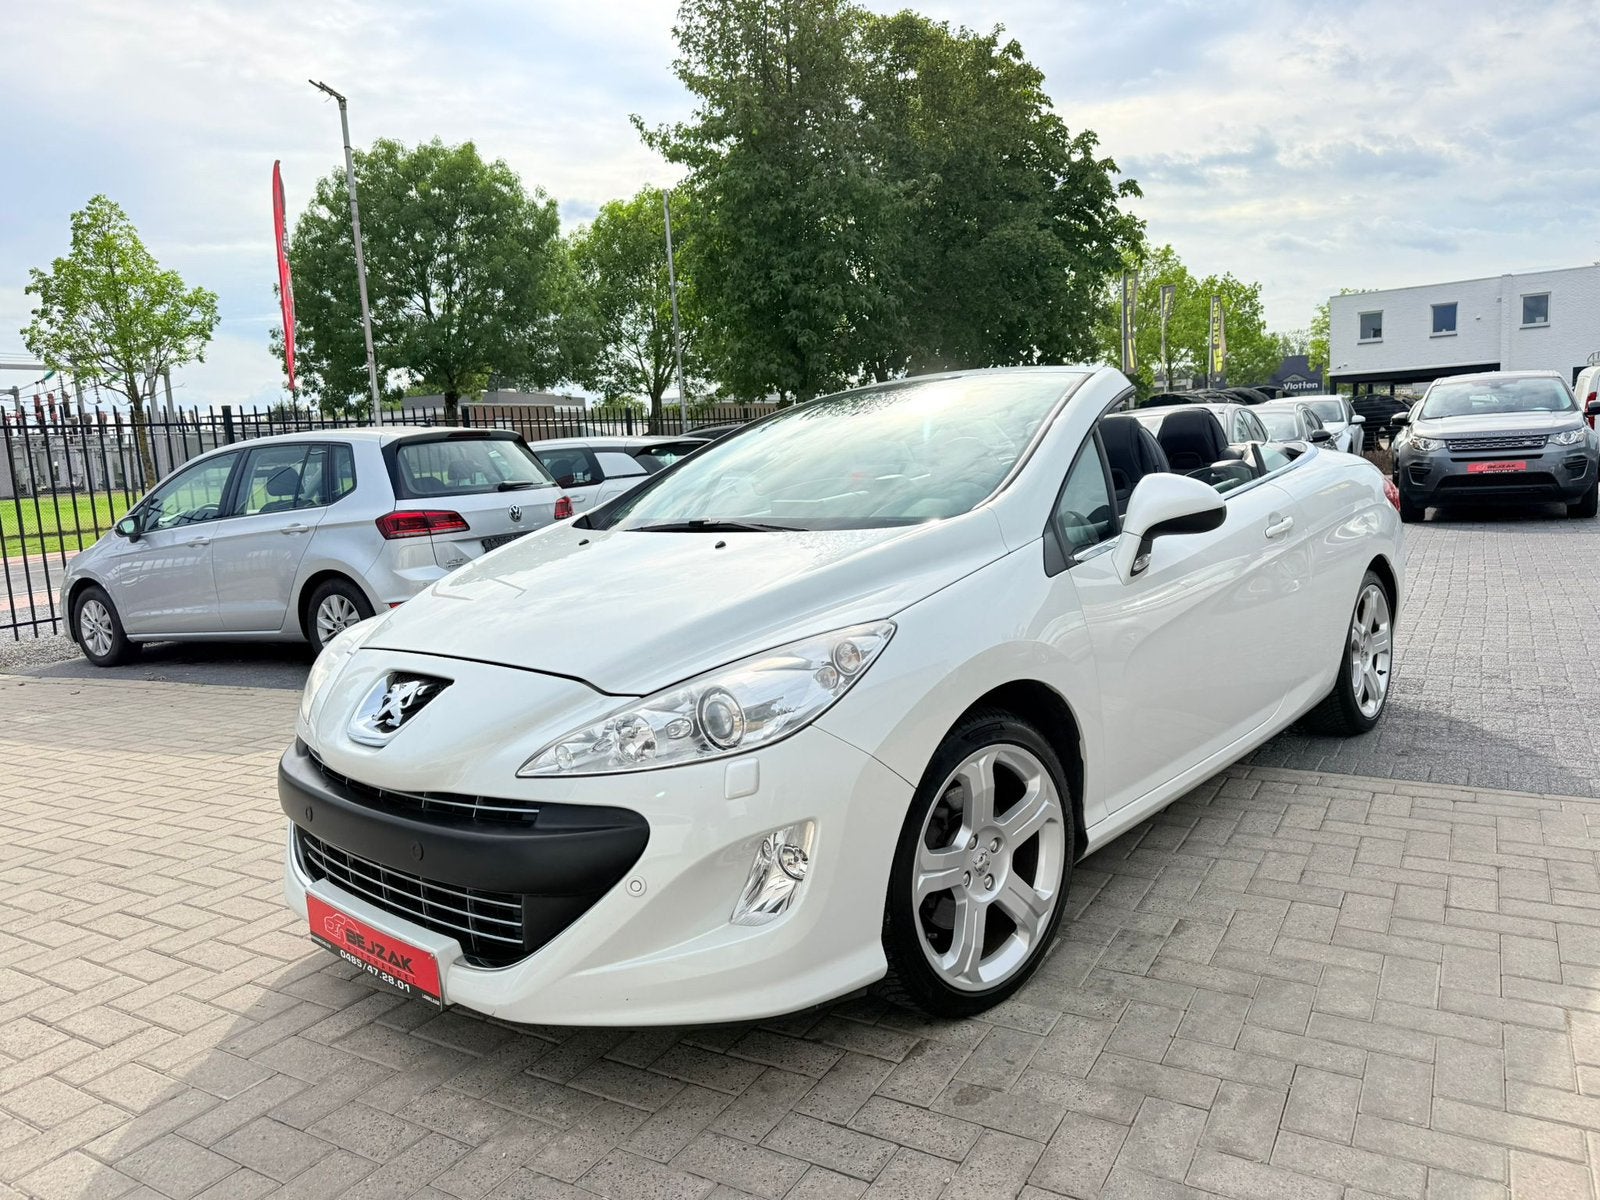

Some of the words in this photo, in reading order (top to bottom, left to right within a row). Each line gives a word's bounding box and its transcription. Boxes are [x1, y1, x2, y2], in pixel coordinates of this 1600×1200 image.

[1283, 381, 1318, 390] Vlotten
[340, 949, 411, 993] 0485/47.28.01
[345, 928, 415, 974] BEJZAK
